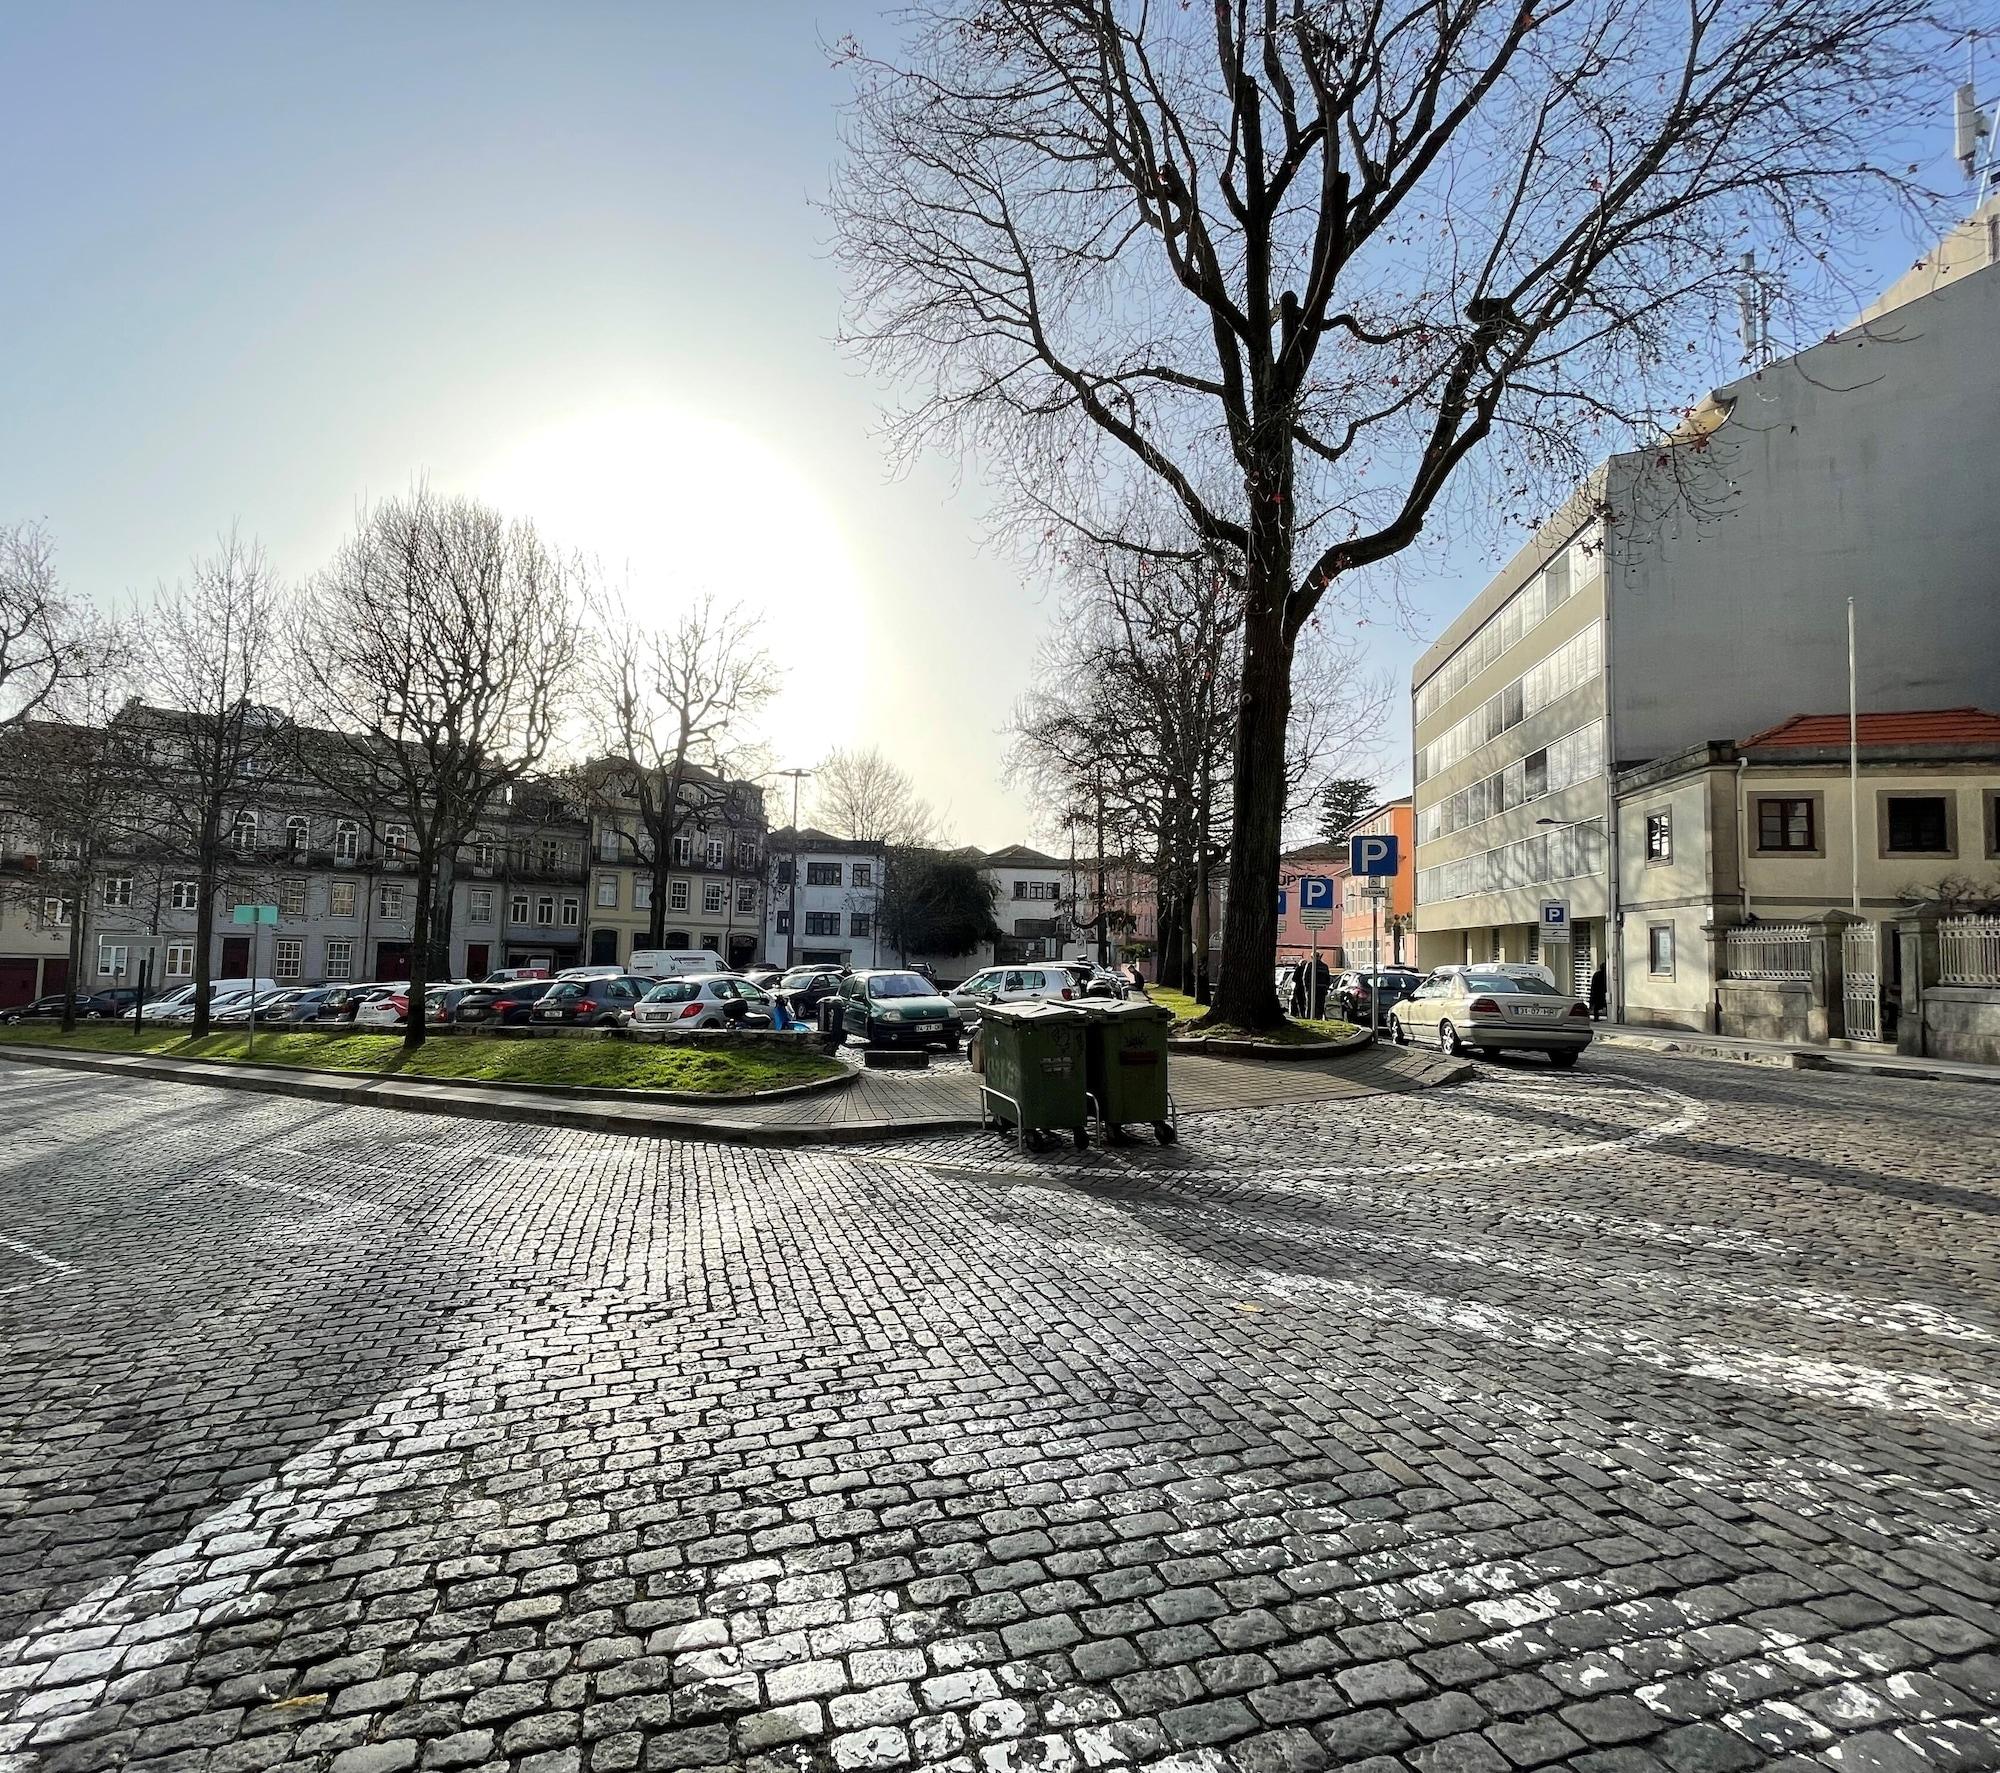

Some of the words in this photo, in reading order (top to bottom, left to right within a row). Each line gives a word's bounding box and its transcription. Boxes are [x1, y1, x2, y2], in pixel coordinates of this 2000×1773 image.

[1361, 839, 1388, 872] P
[1307, 881, 1327, 905] P
[1549, 909, 1561, 921] P
